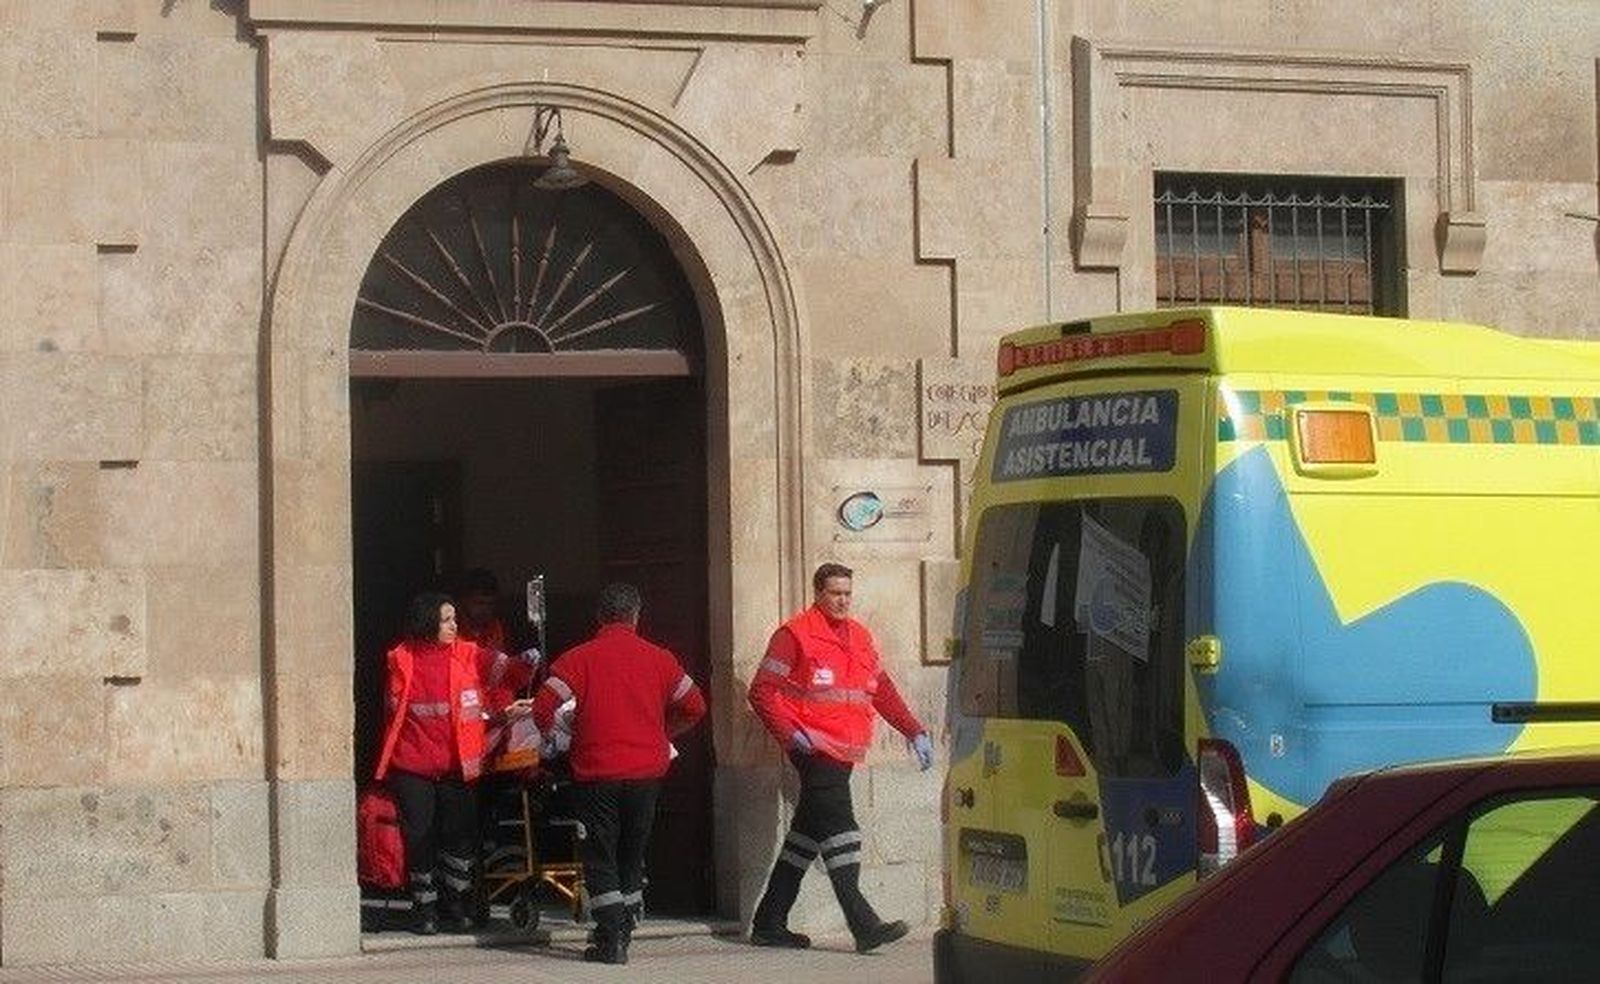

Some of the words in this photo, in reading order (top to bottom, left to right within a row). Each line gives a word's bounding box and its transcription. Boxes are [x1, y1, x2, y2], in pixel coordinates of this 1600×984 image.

[1007, 396, 1160, 437] AMBULANCIA
[1003, 437, 1152, 475] ASISTENCIAL
[1112, 831, 1157, 886] 112
